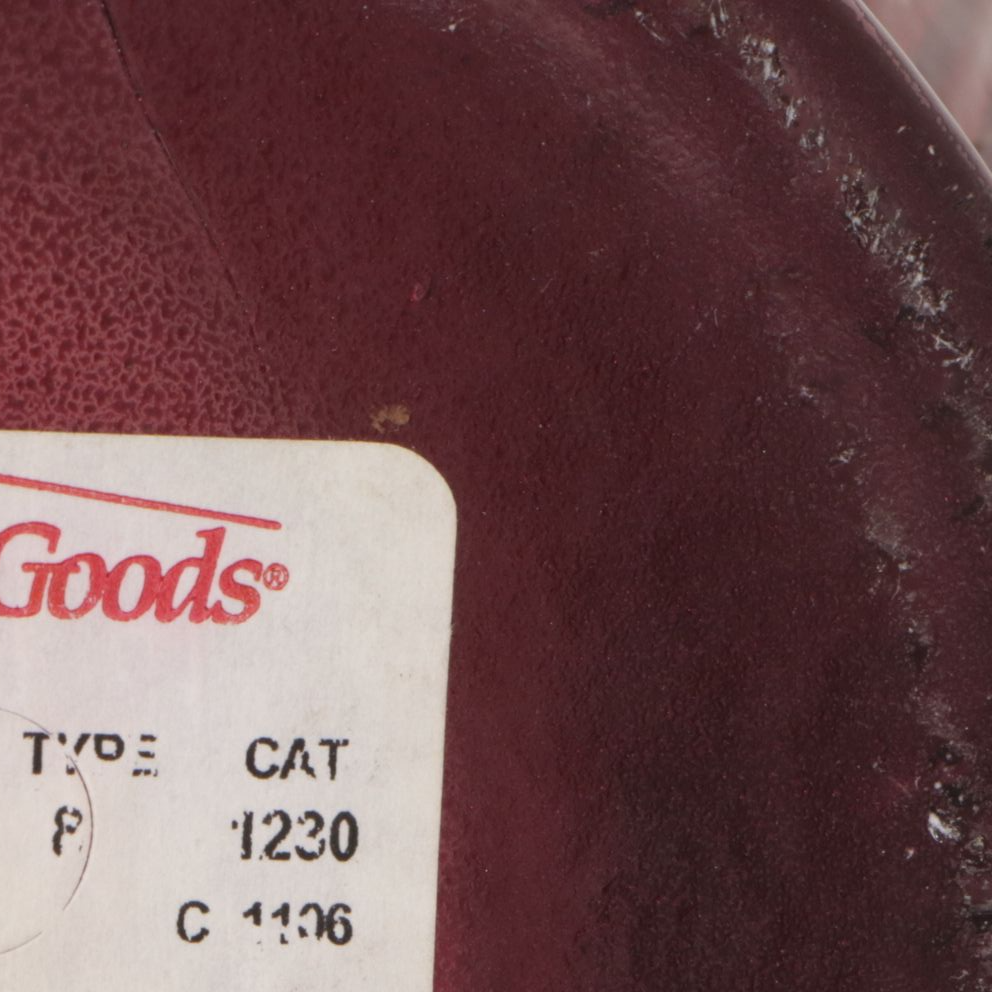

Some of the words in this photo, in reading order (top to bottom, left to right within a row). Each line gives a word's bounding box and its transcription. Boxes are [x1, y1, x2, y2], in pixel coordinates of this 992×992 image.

[246, 738, 350, 781] CAT
[232, 810, 360, 862] 1230
[177, 901, 211, 944] C
